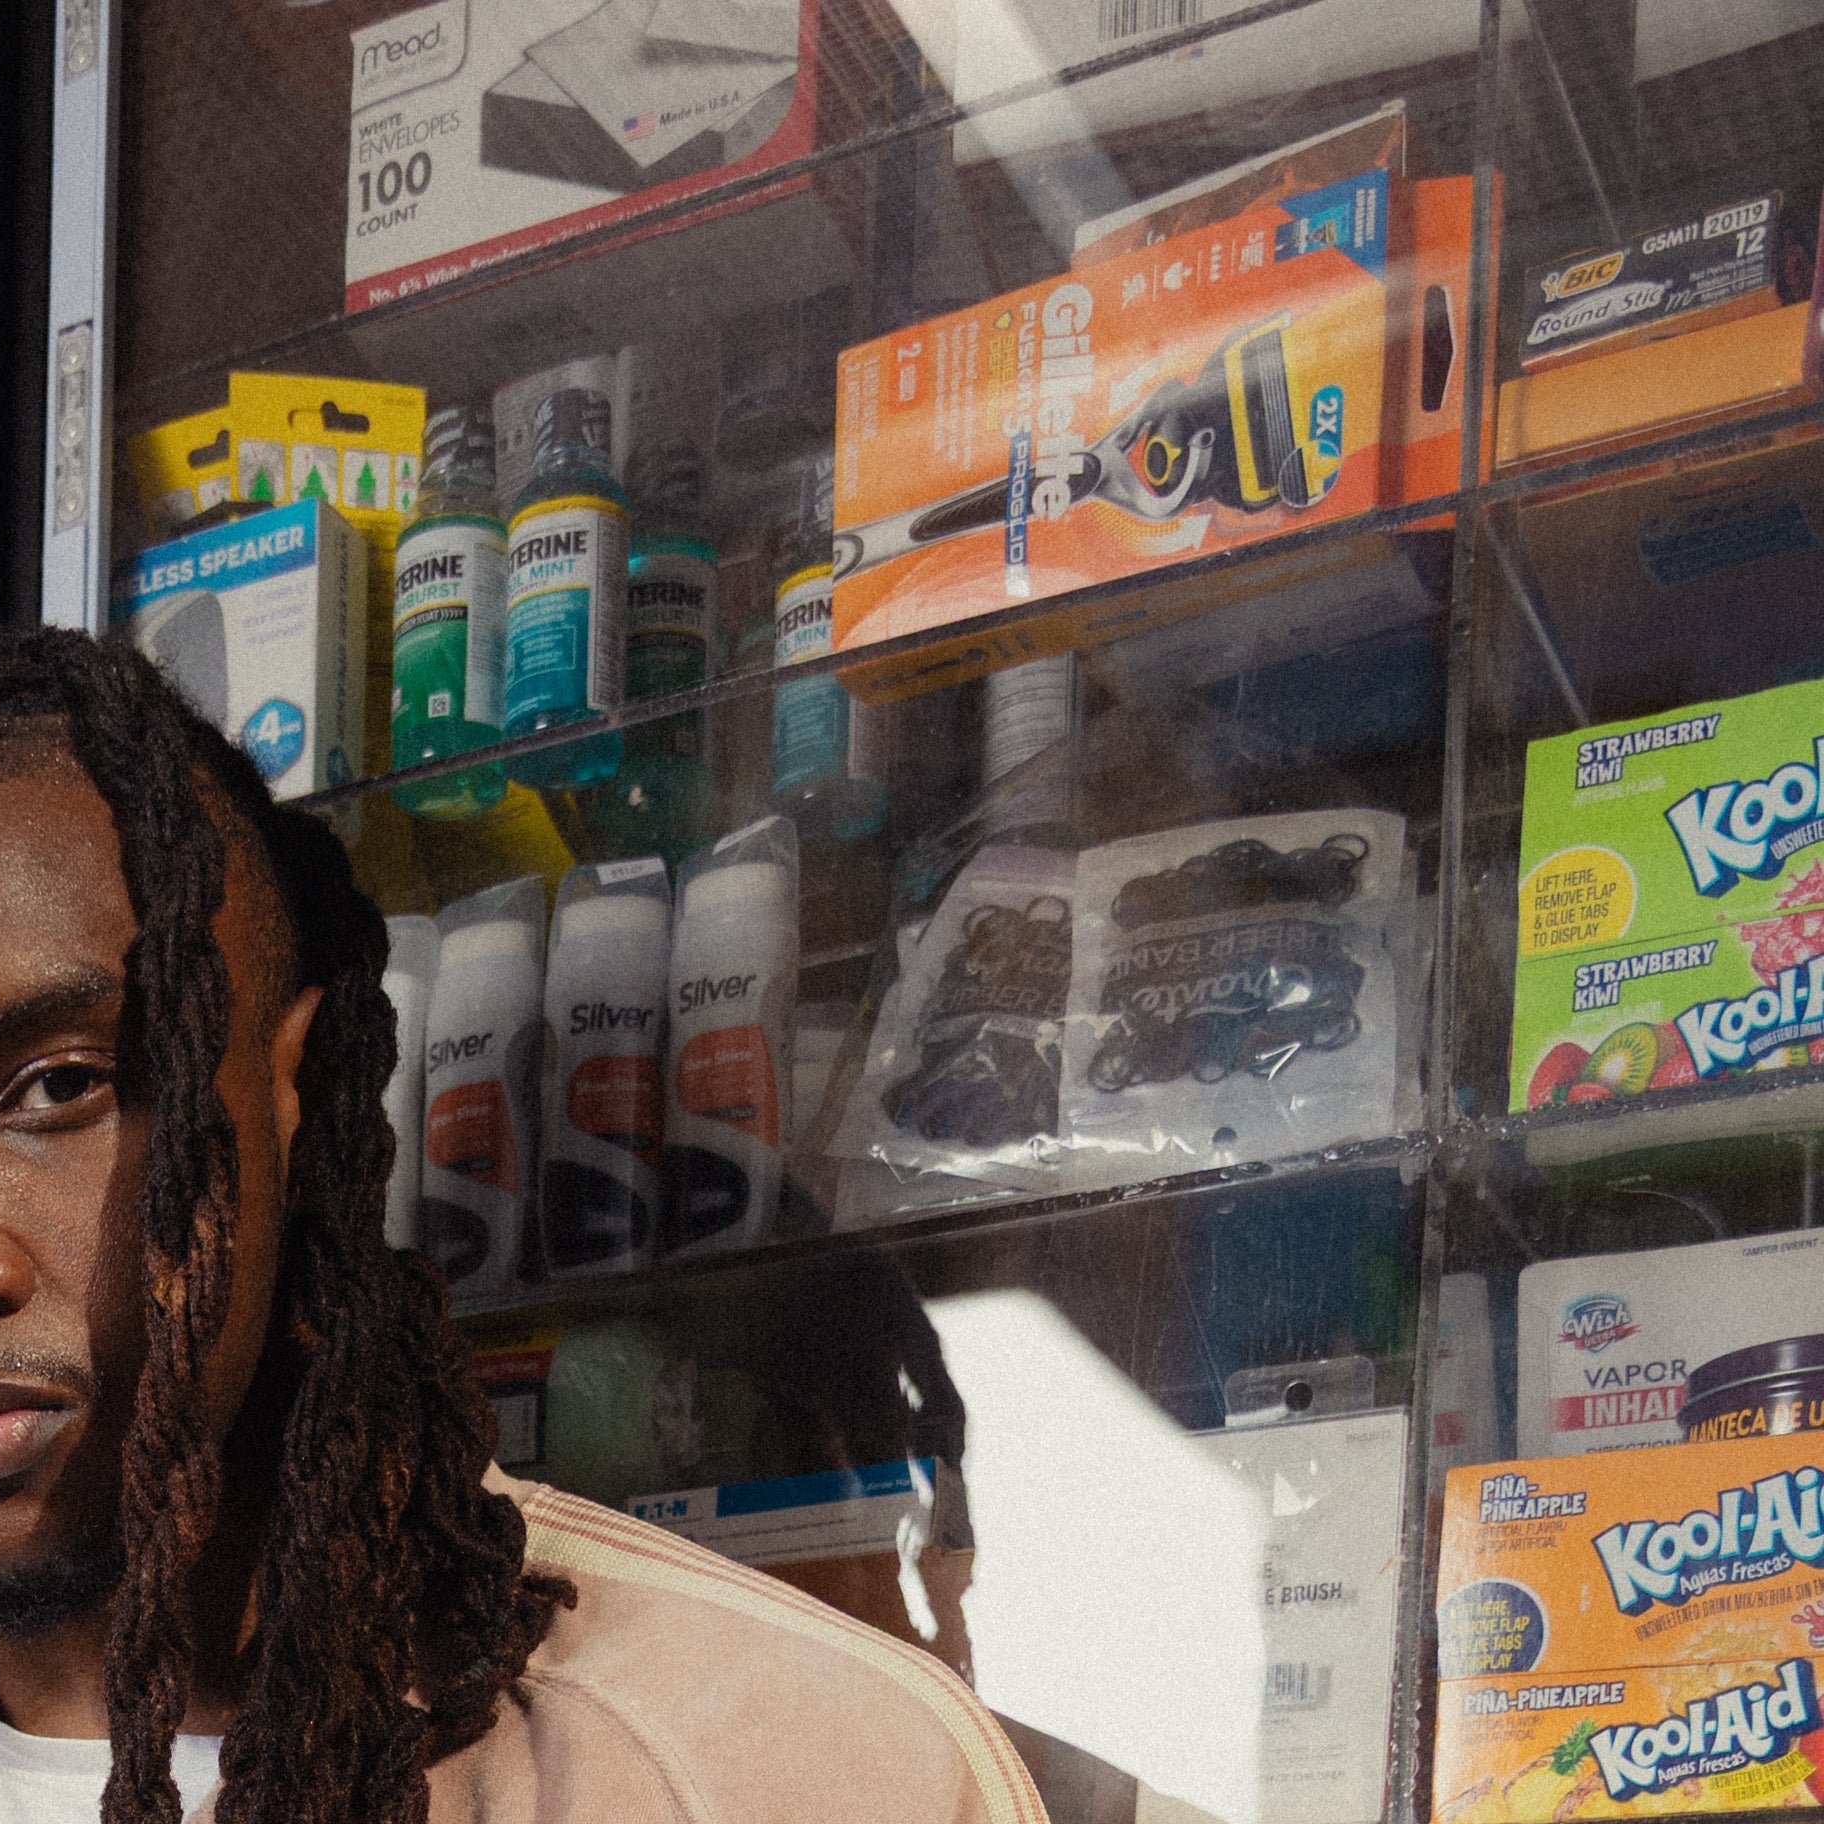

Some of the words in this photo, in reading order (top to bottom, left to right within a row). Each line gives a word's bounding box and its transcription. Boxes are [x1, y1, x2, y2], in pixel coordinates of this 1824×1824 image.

[358, 112, 403, 141] WHITE
[659, 107, 692, 127] Made
[358, 110, 461, 165] ENVELOPES
[358, 151, 433, 213] 100
[356, 203, 420, 238] COUNT
[1642, 221, 1699, 256] GSM11
[1708, 203, 1764, 236] 20119
[1736, 225, 1767, 259] 12
[1533, 300, 1611, 339] Round
[1621, 284, 1665, 313] Stic
[1031, 281, 1095, 523] Gillette
[1315, 396, 1338, 436] 2X
[197, 523, 306, 579] SPEAKER
[528, 557, 577, 580] MINT
[257, 709, 282, 746] 4
[1577, 713, 1722, 765] STRAWBERRY
[1665, 735, 1824, 899] Koo
[1534, 890, 1584, 911] REMOVE
[1586, 881, 1617, 904] FLAP
[1535, 874, 1561, 894] LIFT
[1533, 914, 1543, 930] &
[1545, 906, 1578, 928] GLUE
[1579, 901, 1610, 921] TABS
[1532, 930, 1548, 949] TO
[1549, 922, 1600, 946] DISPLAY
[1574, 938, 1719, 989] STRAWBERRY
[677, 973, 758, 1016] Silver
[568, 1001, 656, 1037] Silver
[1742, 1243, 1778, 1258] TAMPER
[1779, 1237, 1819, 1254] EVIDENT
[1562, 1303, 1633, 1339] Wish
[1584, 1359, 1690, 1390] VAPOR
[1688, 1406, 1768, 1444] MANTECA
[1591, 1466, 1824, 1617] Kool-Ai
[1680, 1565, 1728, 1596] Aguas
[1730, 1551, 1792, 1582] Frescas
[1280, 1582, 1344, 1605] BRUSH
[1492, 1633, 1523, 1650] TABS
[1500, 1616, 1531, 1632] FLAP
[1589, 1657, 1820, 1801] Kool-Aid
[1657, 1758, 1696, 1786] Aguas
[1698, 1750, 1747, 1775] Frescas
